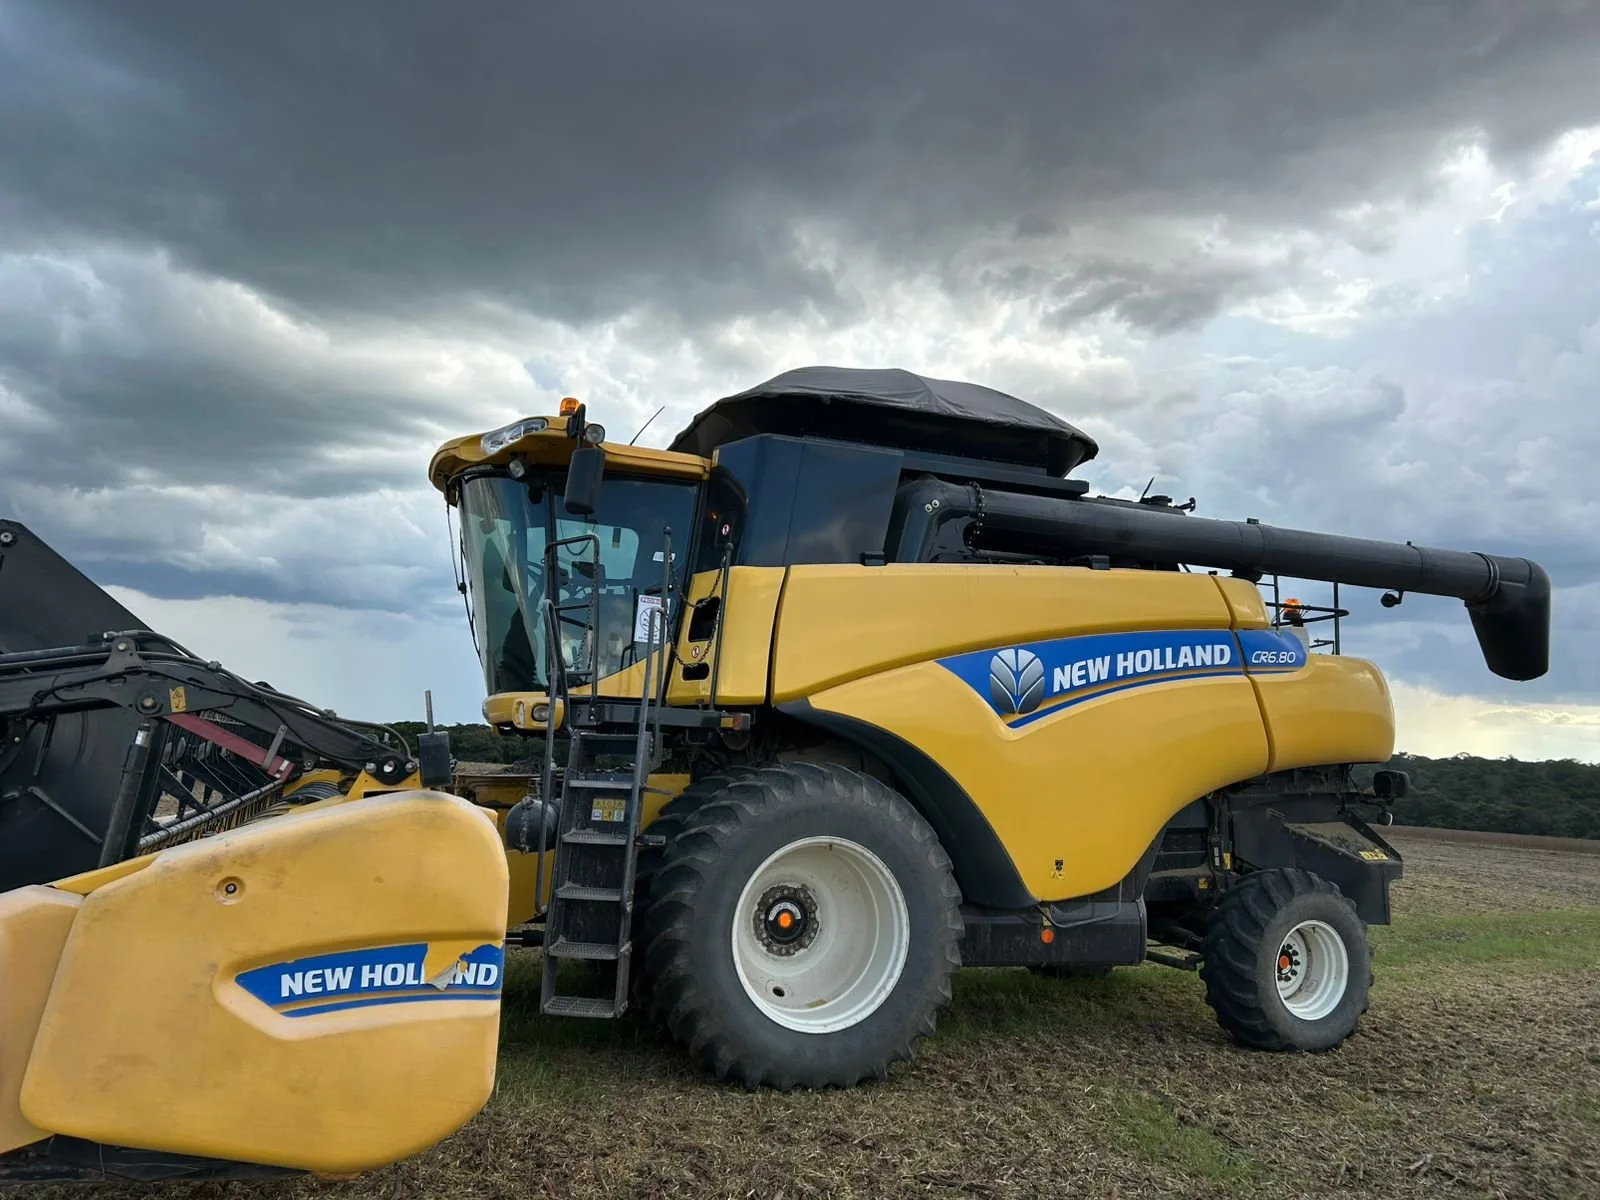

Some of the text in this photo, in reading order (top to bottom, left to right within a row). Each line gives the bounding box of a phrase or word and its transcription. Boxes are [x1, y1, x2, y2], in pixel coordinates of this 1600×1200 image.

[1053, 644, 1231, 692] NEW HOLLAND
[1251, 650, 1296, 664] CR6.80
[280, 962, 498, 997] NEW HOLND
